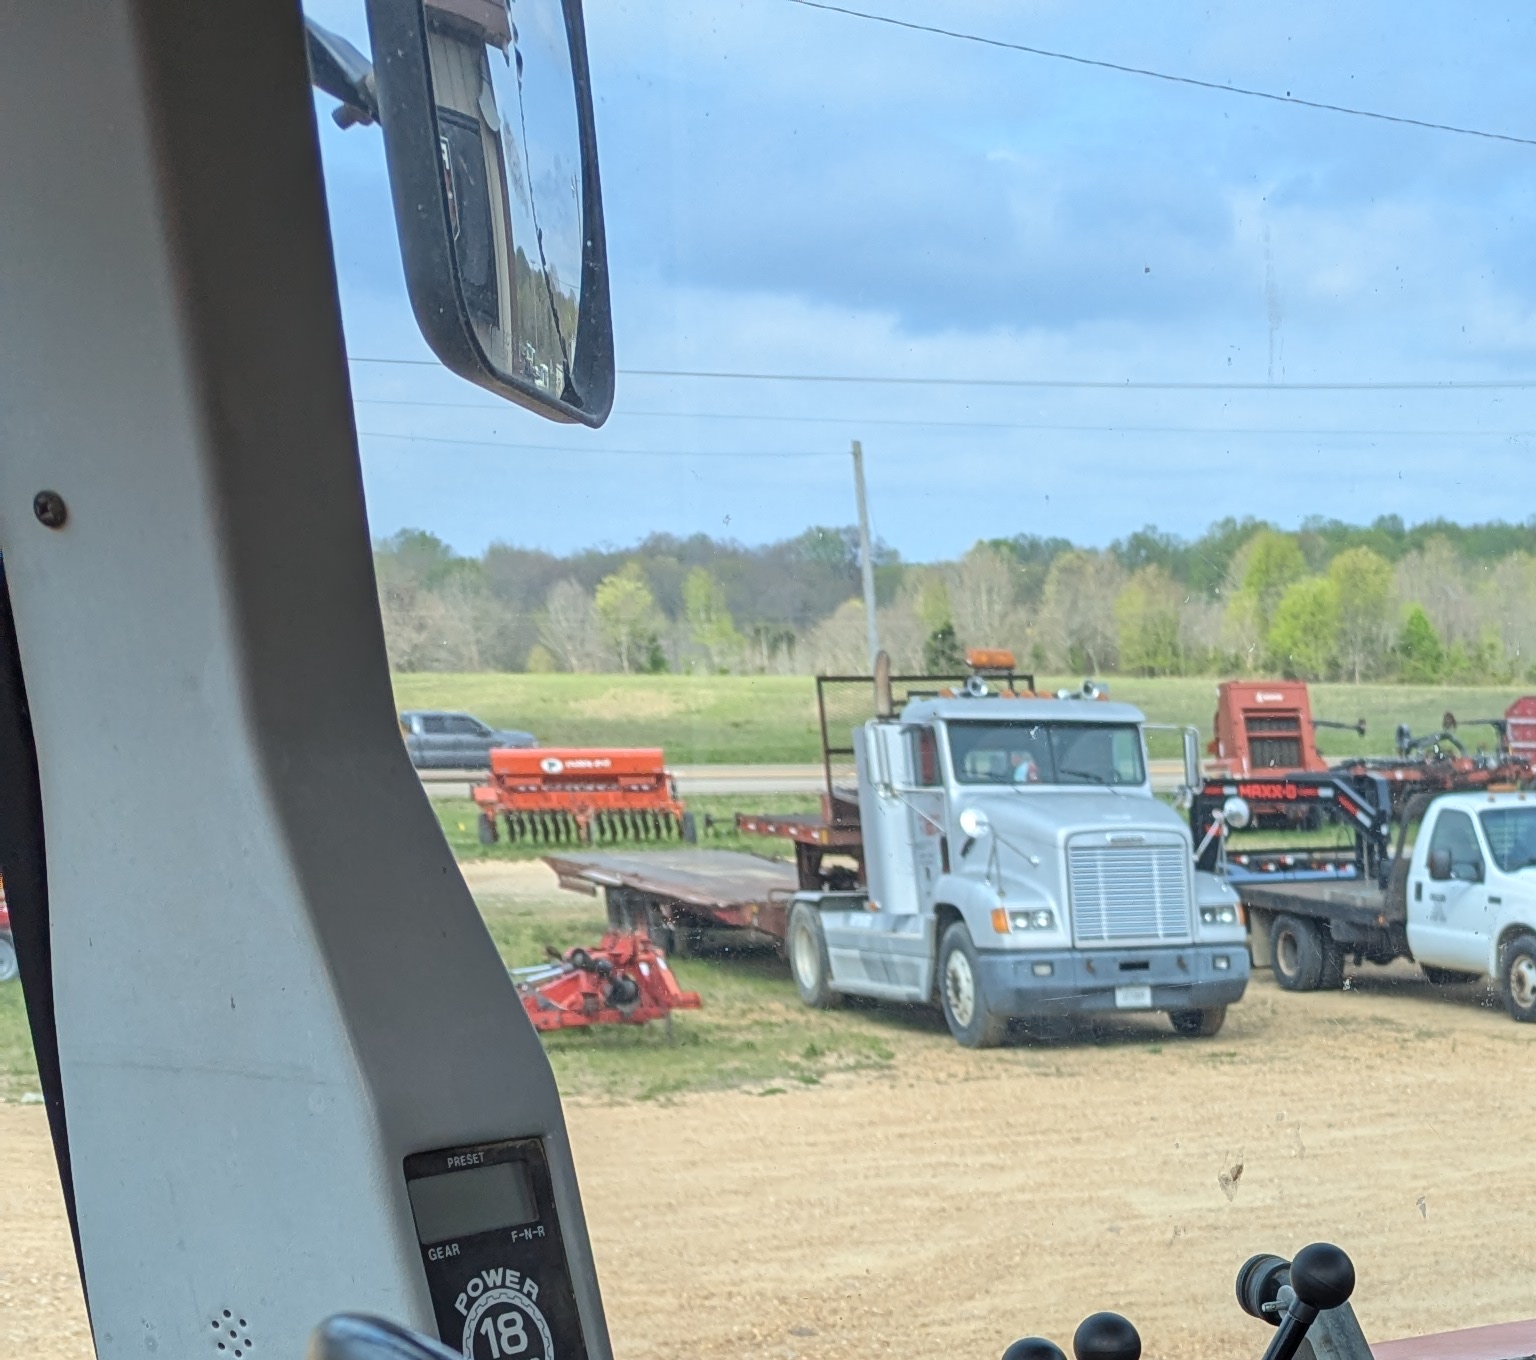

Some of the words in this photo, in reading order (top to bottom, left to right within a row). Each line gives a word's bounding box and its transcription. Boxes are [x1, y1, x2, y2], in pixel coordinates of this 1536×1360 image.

[447, 1152, 484, 1167] PRESET
[511, 1225, 546, 1242] F-N-R
[428, 1243, 461, 1261] GEAR
[454, 1267, 539, 1316] POWER
[480, 1311, 529, 1359] 18
